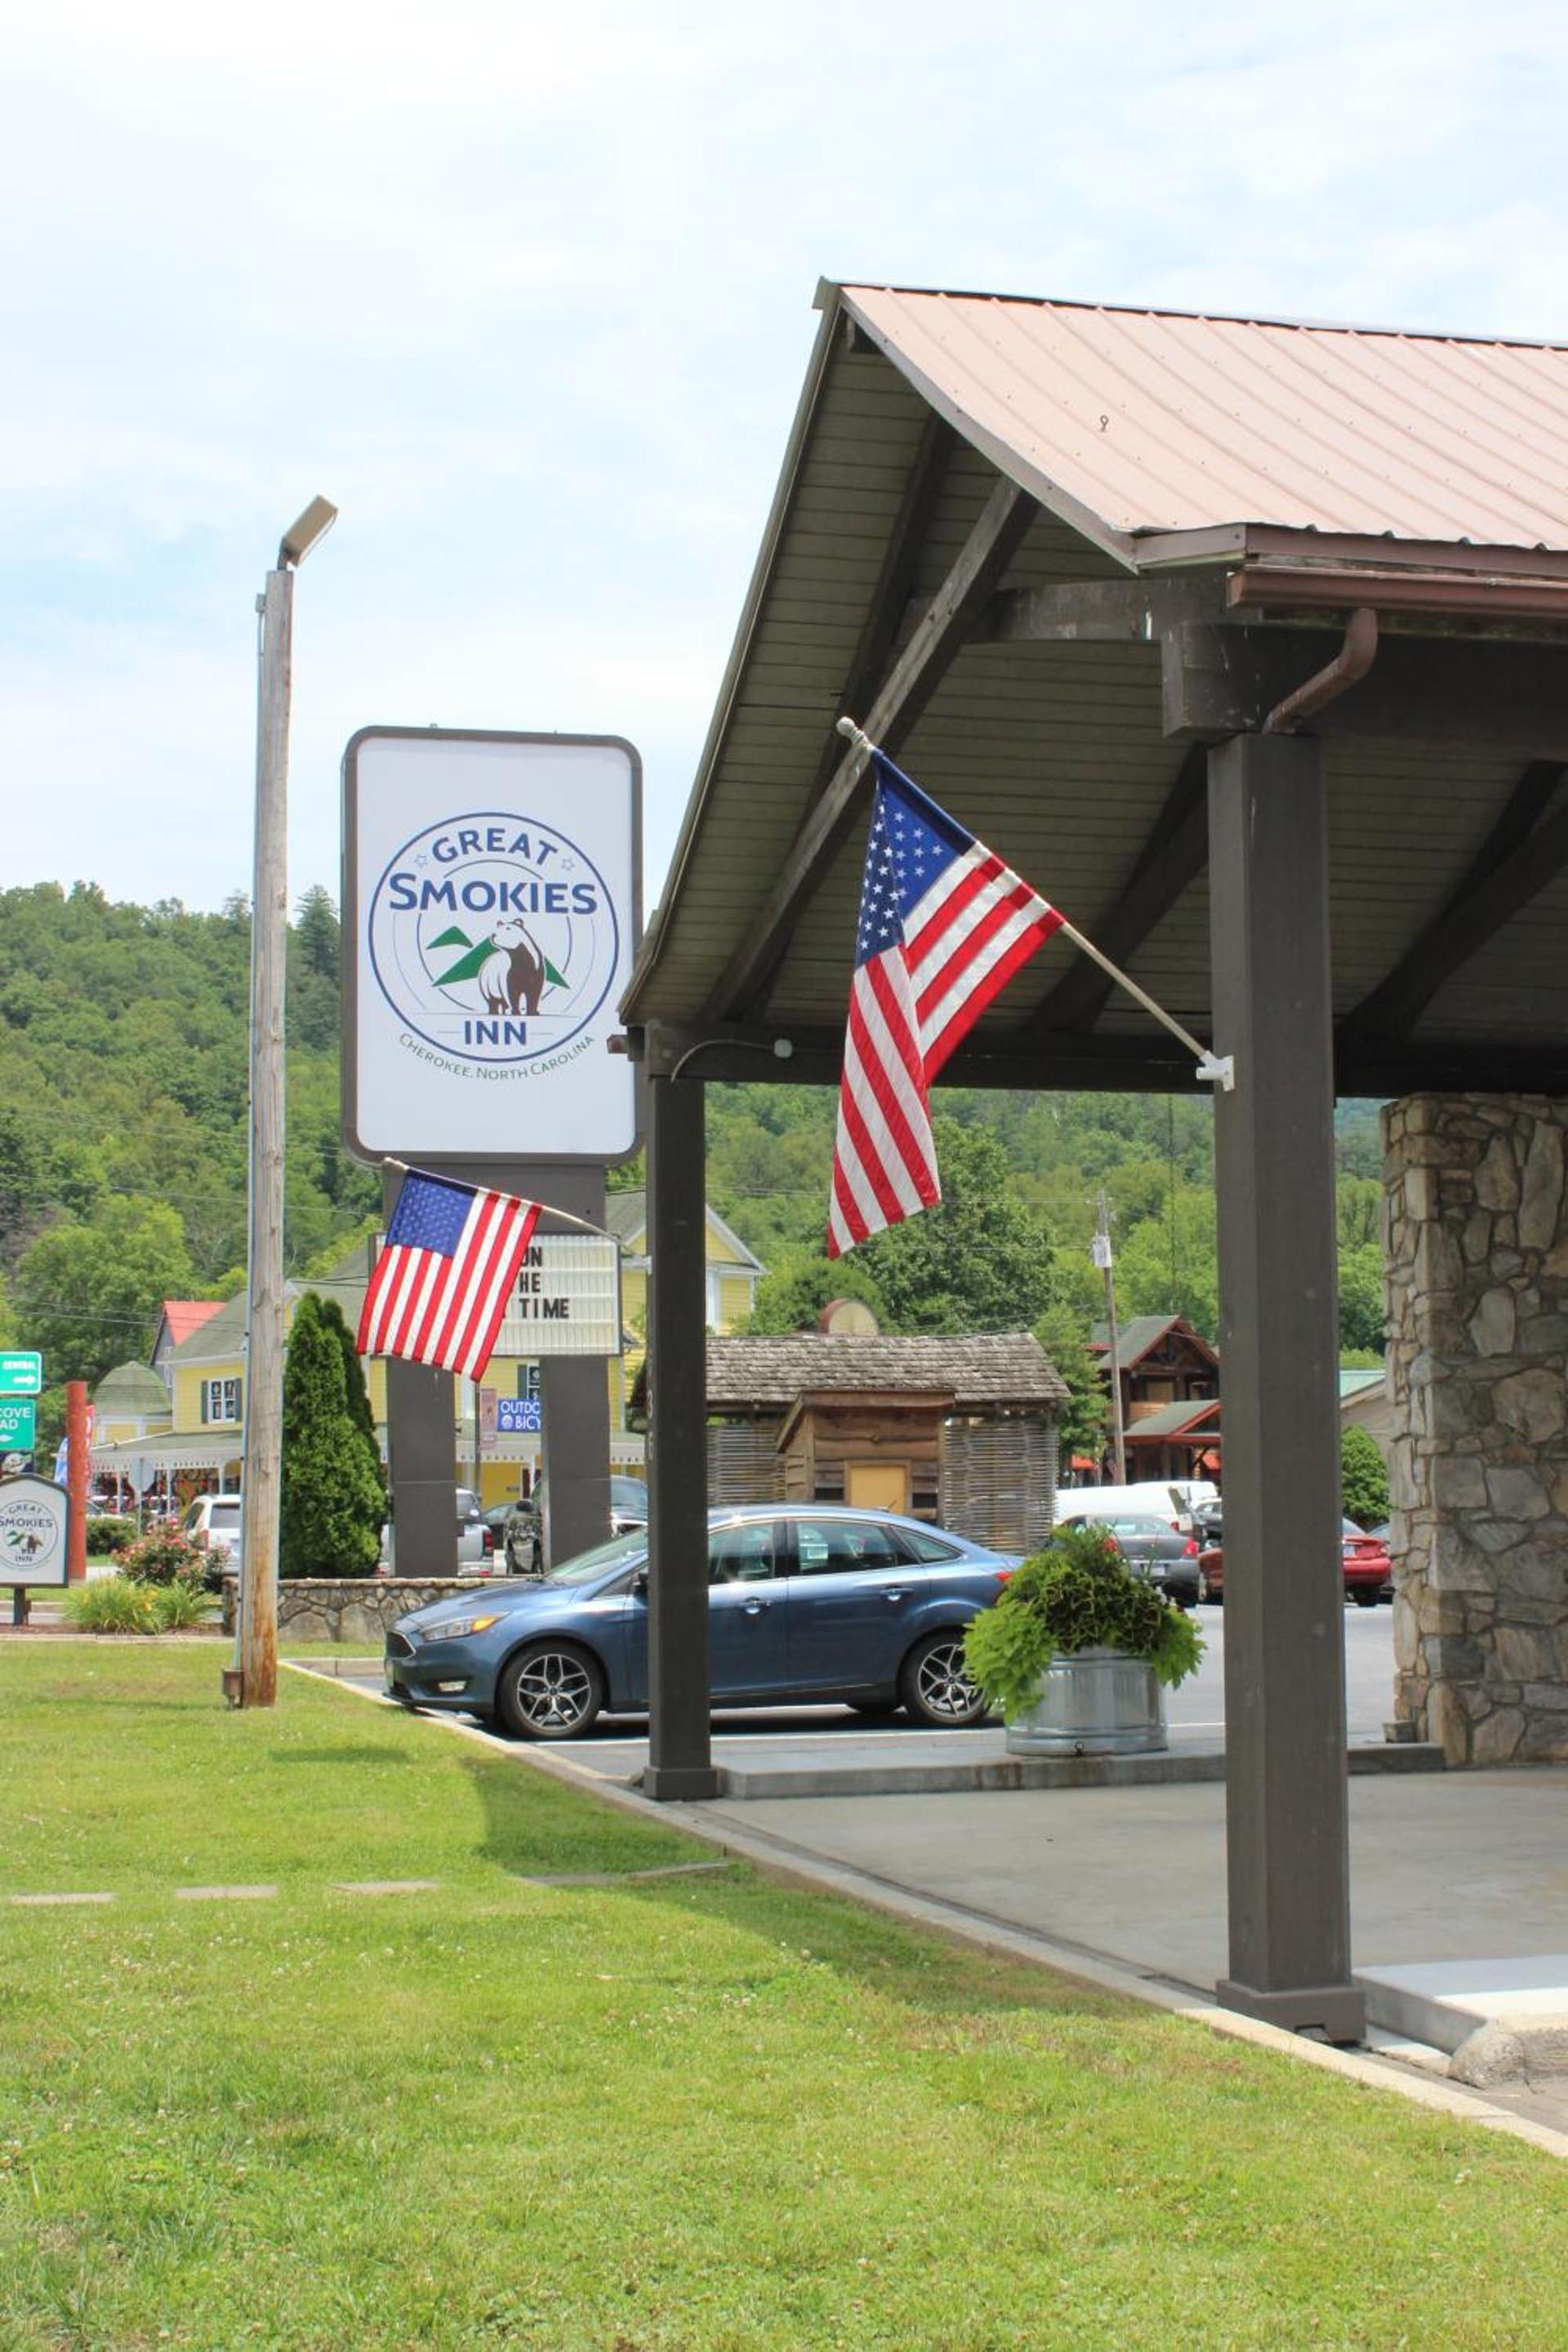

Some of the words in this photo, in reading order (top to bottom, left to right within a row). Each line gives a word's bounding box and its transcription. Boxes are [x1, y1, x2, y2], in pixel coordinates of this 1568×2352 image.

[432, 827, 559, 866] GREAT
[390, 872, 598, 914] SMOKIES
[464, 1020, 527, 1046] INN
[476, 1067, 528, 1080] NORTH
[530, 1035, 595, 1076] CAROLINA
[519, 1272, 541, 1293] HE
[519, 1297, 569, 1319] TIME
[0, 1407, 31, 1419] OVE
[0, 1419, 18, 1430] AD
